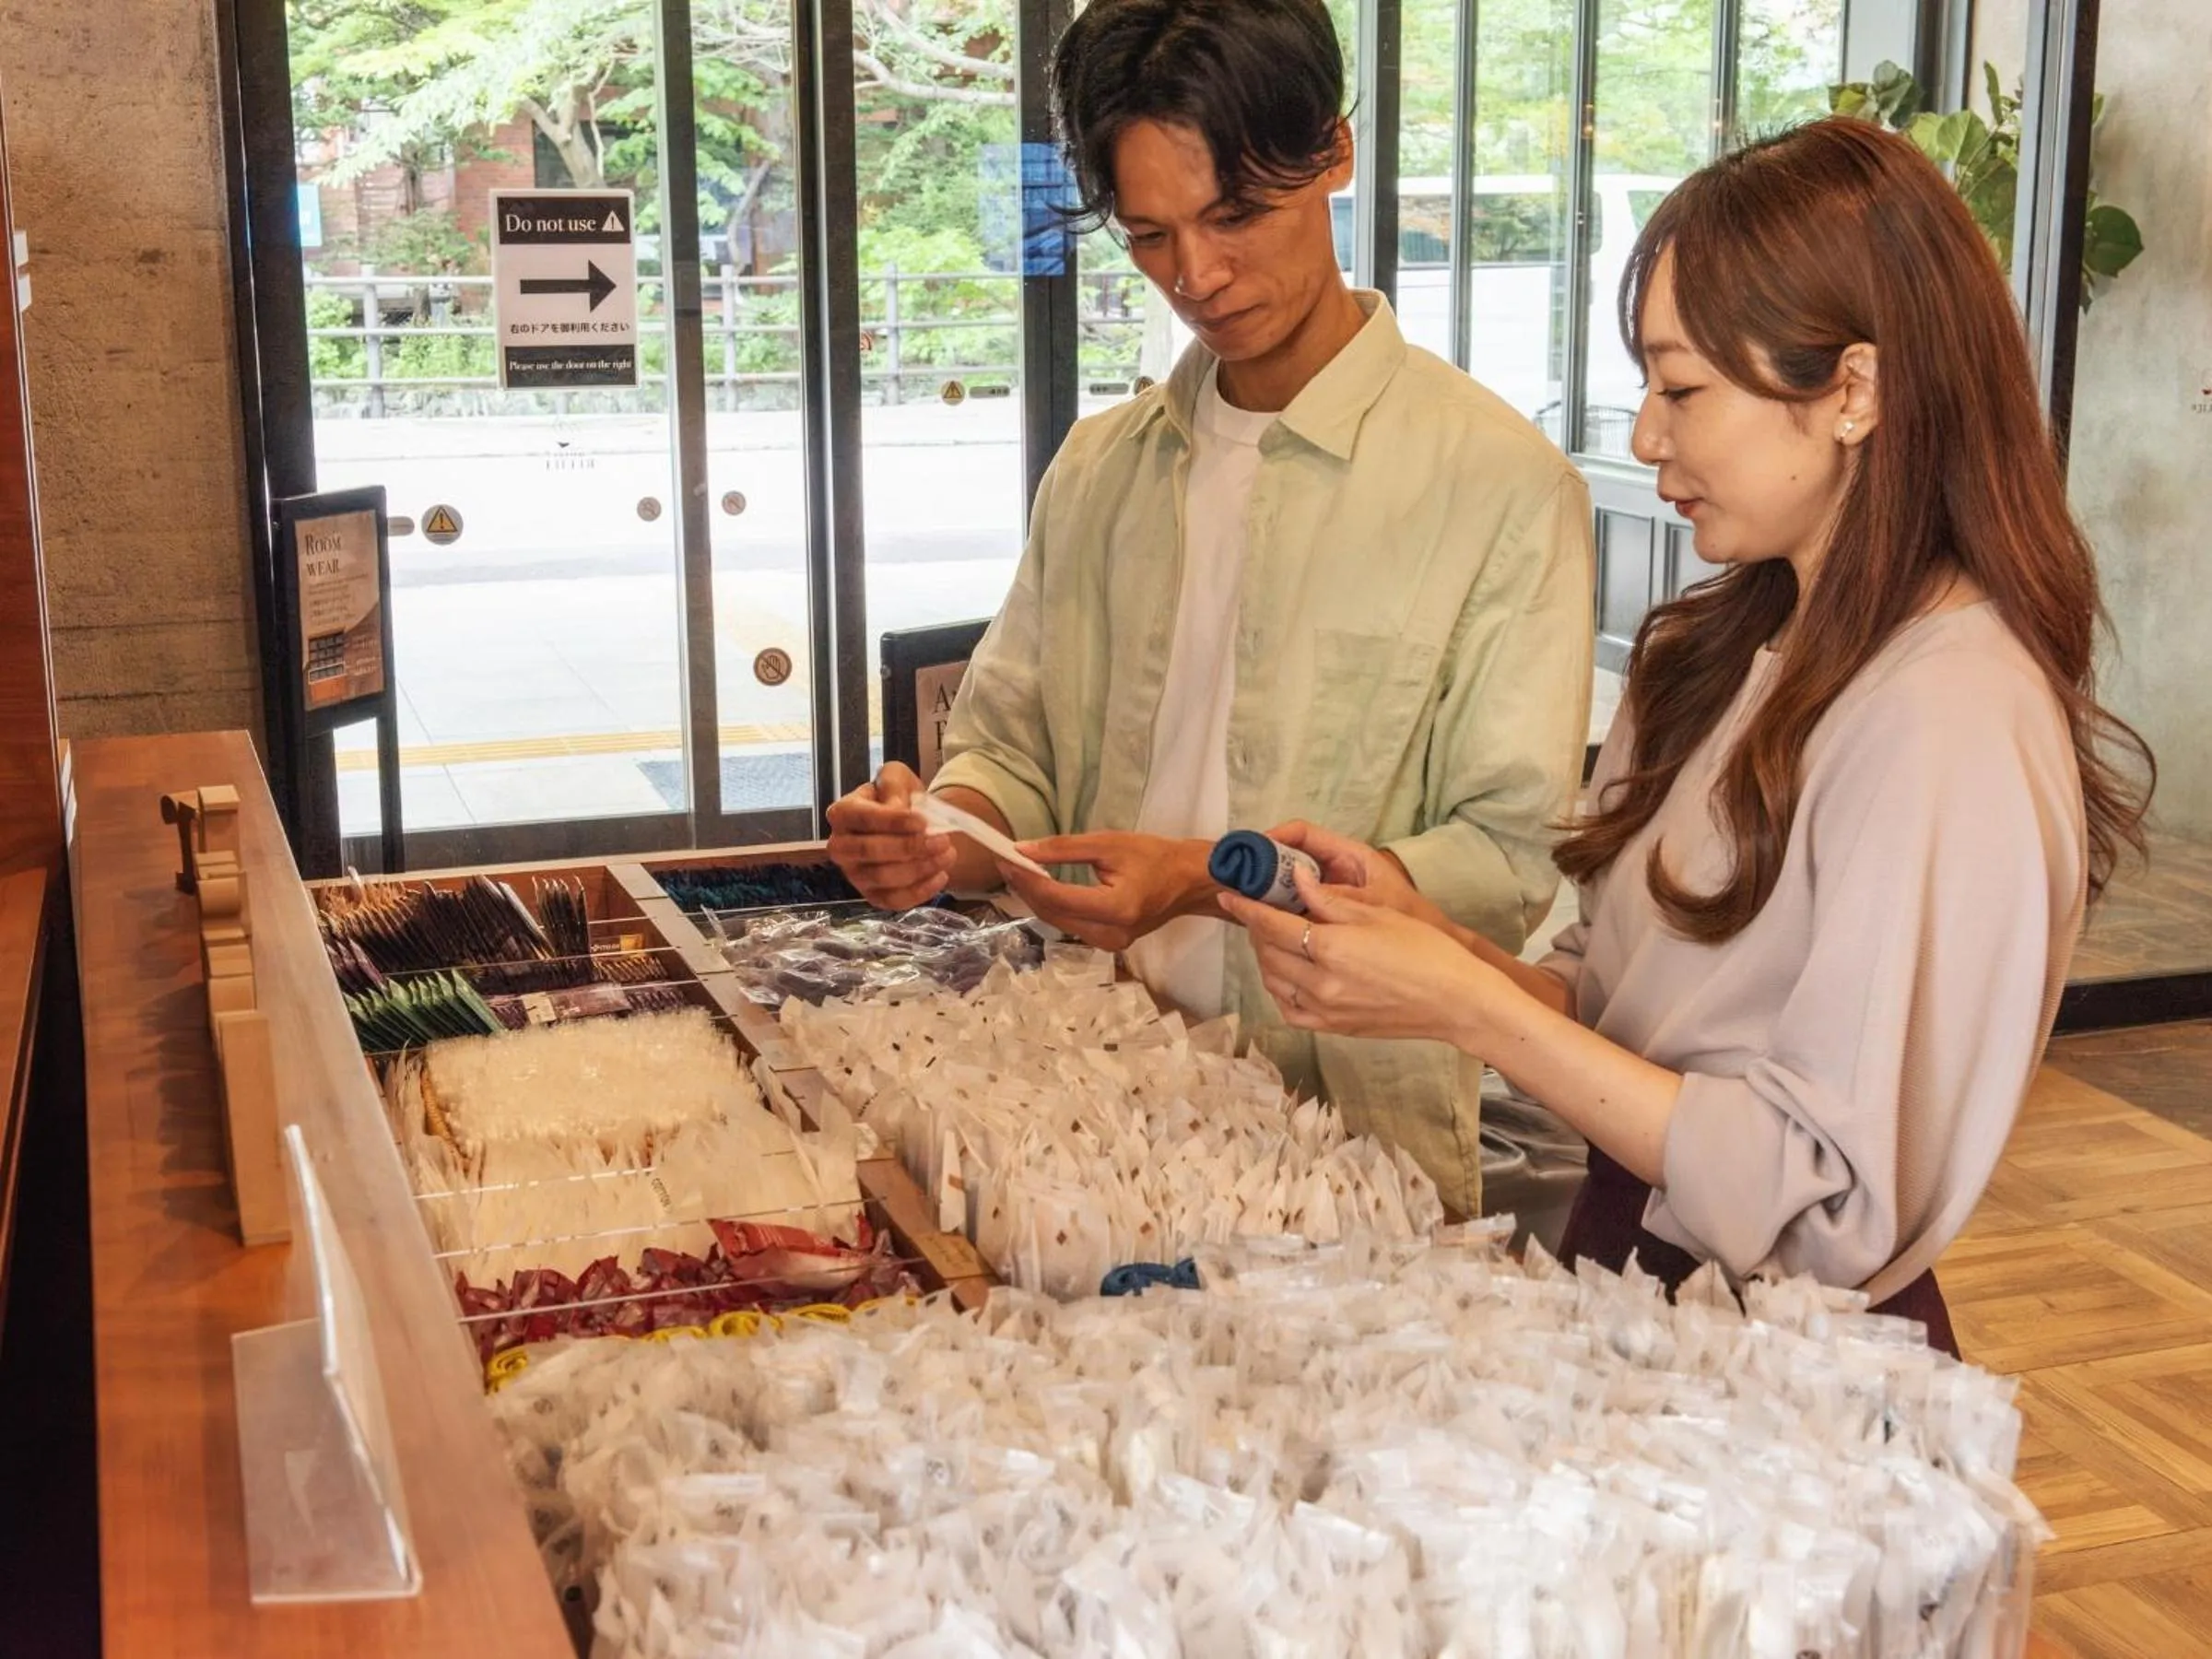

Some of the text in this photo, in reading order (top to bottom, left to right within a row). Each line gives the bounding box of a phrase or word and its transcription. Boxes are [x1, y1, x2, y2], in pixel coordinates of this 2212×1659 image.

[506, 214, 596, 232] Do not use
[511, 322, 630, 334] 右のドアを御利用ください
[510, 360, 535, 371] Please
[551, 360, 563, 370] the
[565, 359, 584, 369] door
[598, 359, 610, 369] the
[612, 359, 631, 371] right
